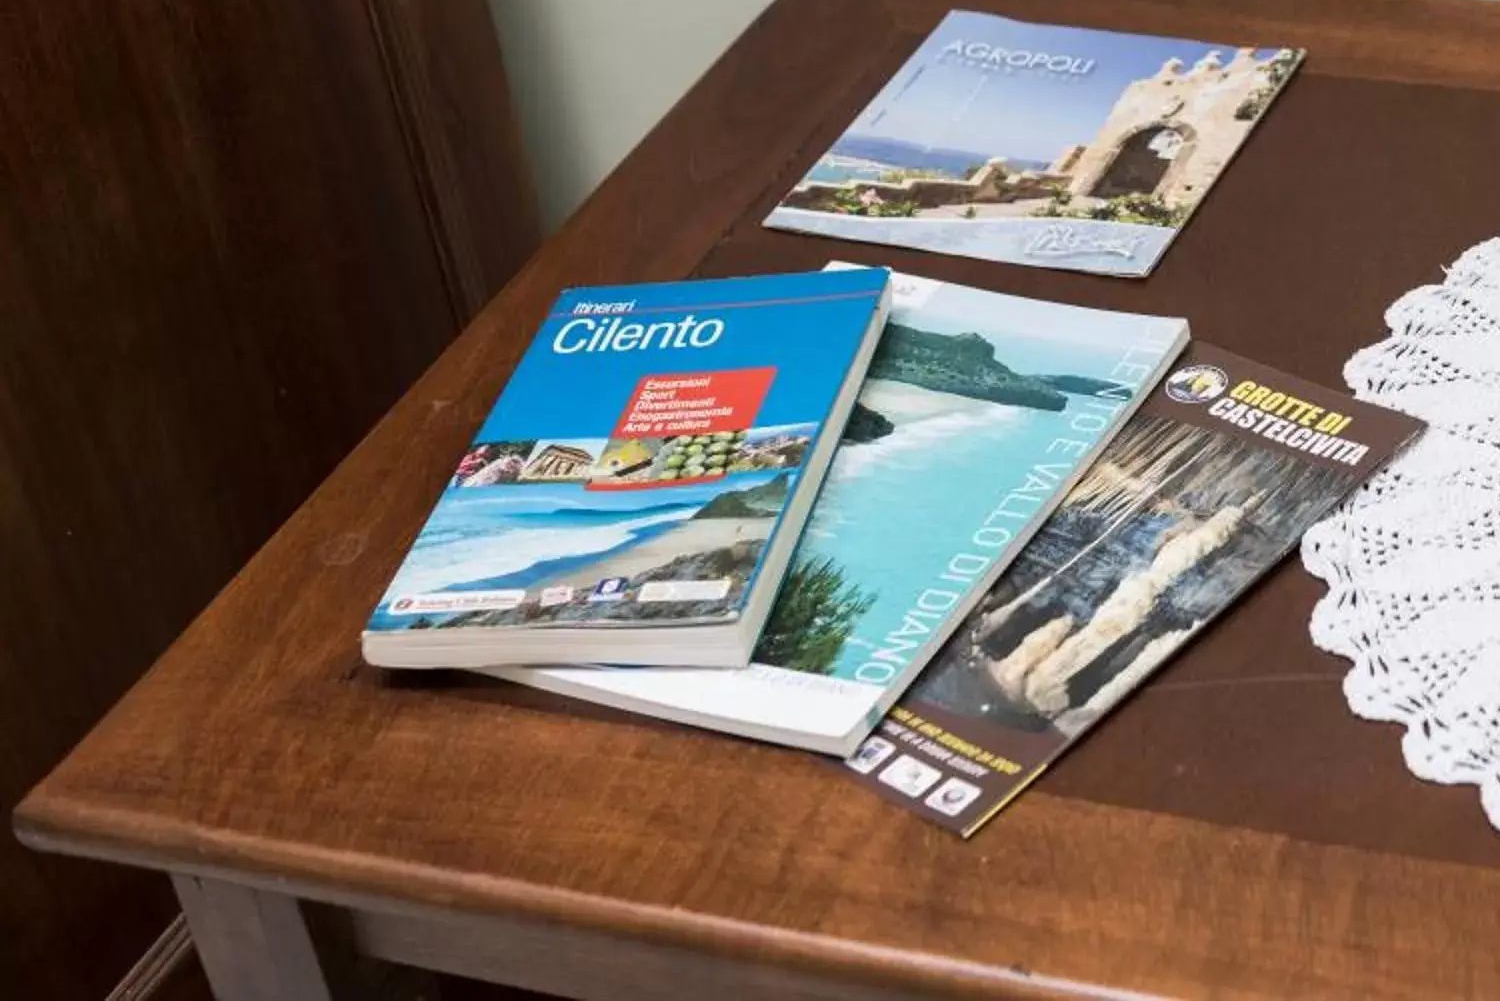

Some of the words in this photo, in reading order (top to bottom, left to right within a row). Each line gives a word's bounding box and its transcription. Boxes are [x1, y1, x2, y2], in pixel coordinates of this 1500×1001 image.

[941, 39, 1097, 75] AGROPOLI
[573, 298, 637, 314] Itinerari
[552, 314, 725, 354] Cilento
[634, 397, 717, 411] Divertimenti
[639, 390, 677, 401] Sport
[1229, 380, 1326, 426] GROTTE
[1314, 411, 1354, 436] DI
[623, 421, 651, 432] Arte
[666, 419, 712, 431] cultura
[1207, 397, 1371, 466] CASTELCIVITA
[1044, 435, 1090, 458] E
[971, 461, 1074, 547] VALLO
[938, 552, 991, 583] DI
[854, 587, 960, 684] DIANO
